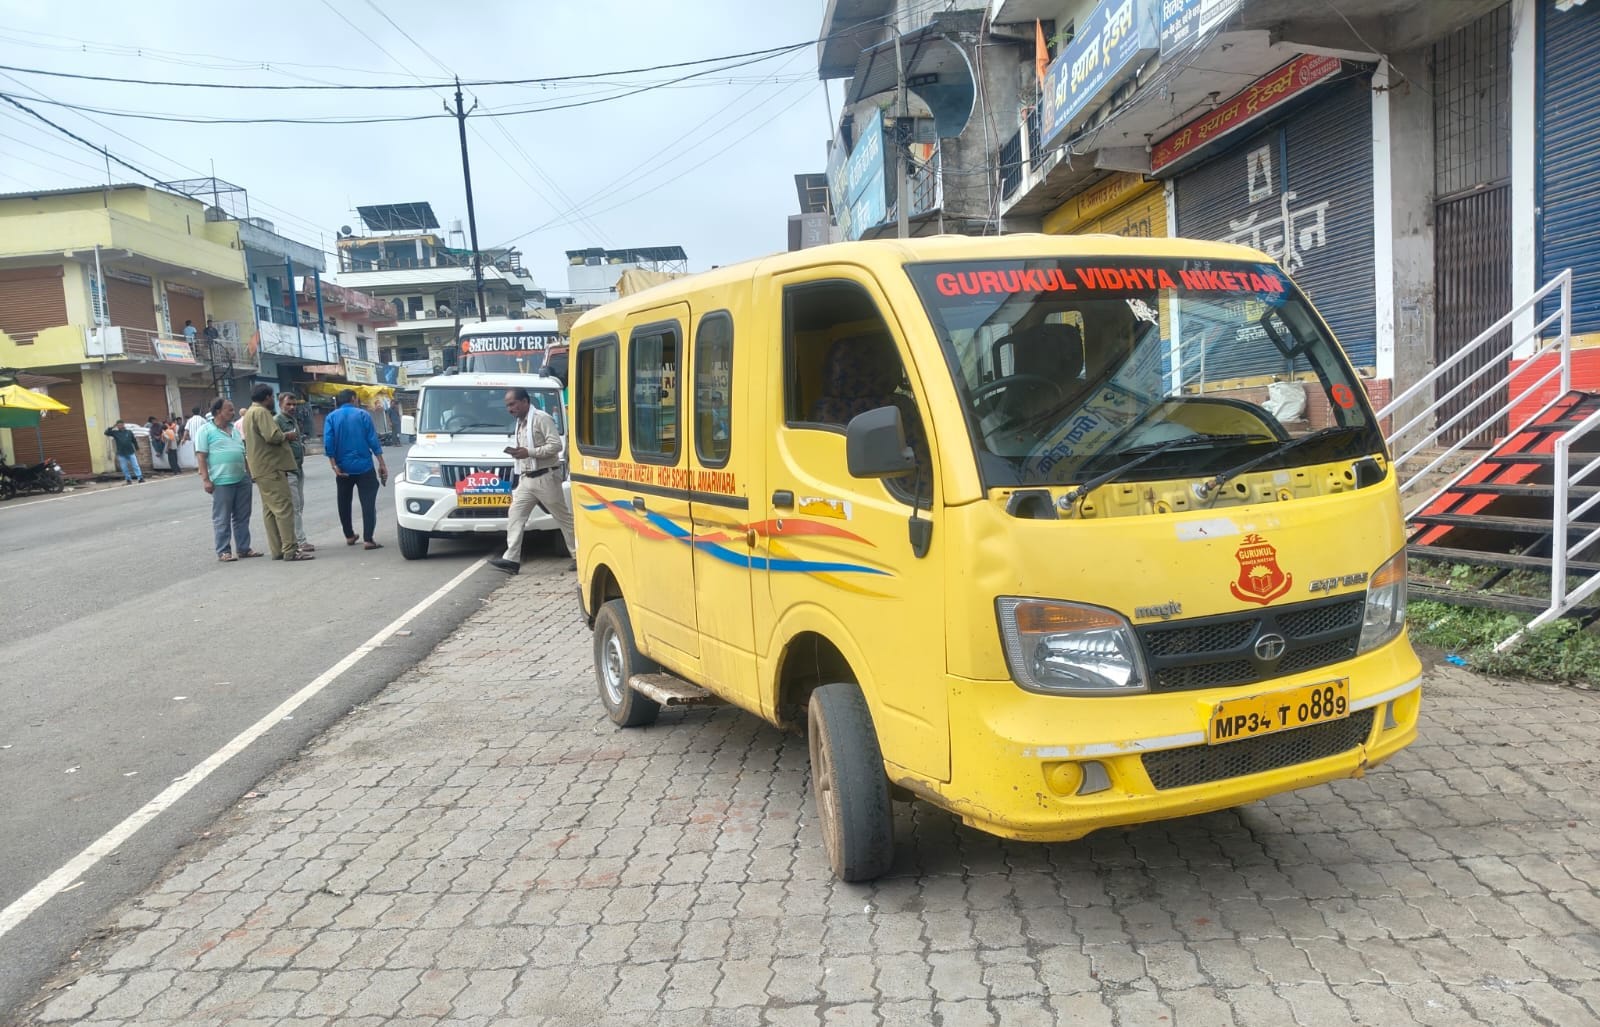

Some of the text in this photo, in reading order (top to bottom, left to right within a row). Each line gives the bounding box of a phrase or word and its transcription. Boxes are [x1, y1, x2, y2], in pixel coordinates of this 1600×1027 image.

[1055, 63, 1068, 111] श्री
[1071, 32, 1101, 94] श्याम
[1173, 129, 1193, 151] श्री
[1198, 102, 1241, 138] श्याम
[936, 267, 1285, 297] GURUKUL VIDHYA NIKETAN
[469, 336, 517, 353] SATGURU
[467, 477, 500, 487] R.T.O
[657, 467, 671, 487] HIGH
[672, 468, 696, 491] SCHOOL
[697, 471, 736, 495] AMARWARA
[1238, 547, 1274, 560] GURUKUL
[1135, 599, 1182, 620] magic
[1215, 686, 1347, 739] MP34 T 0889
